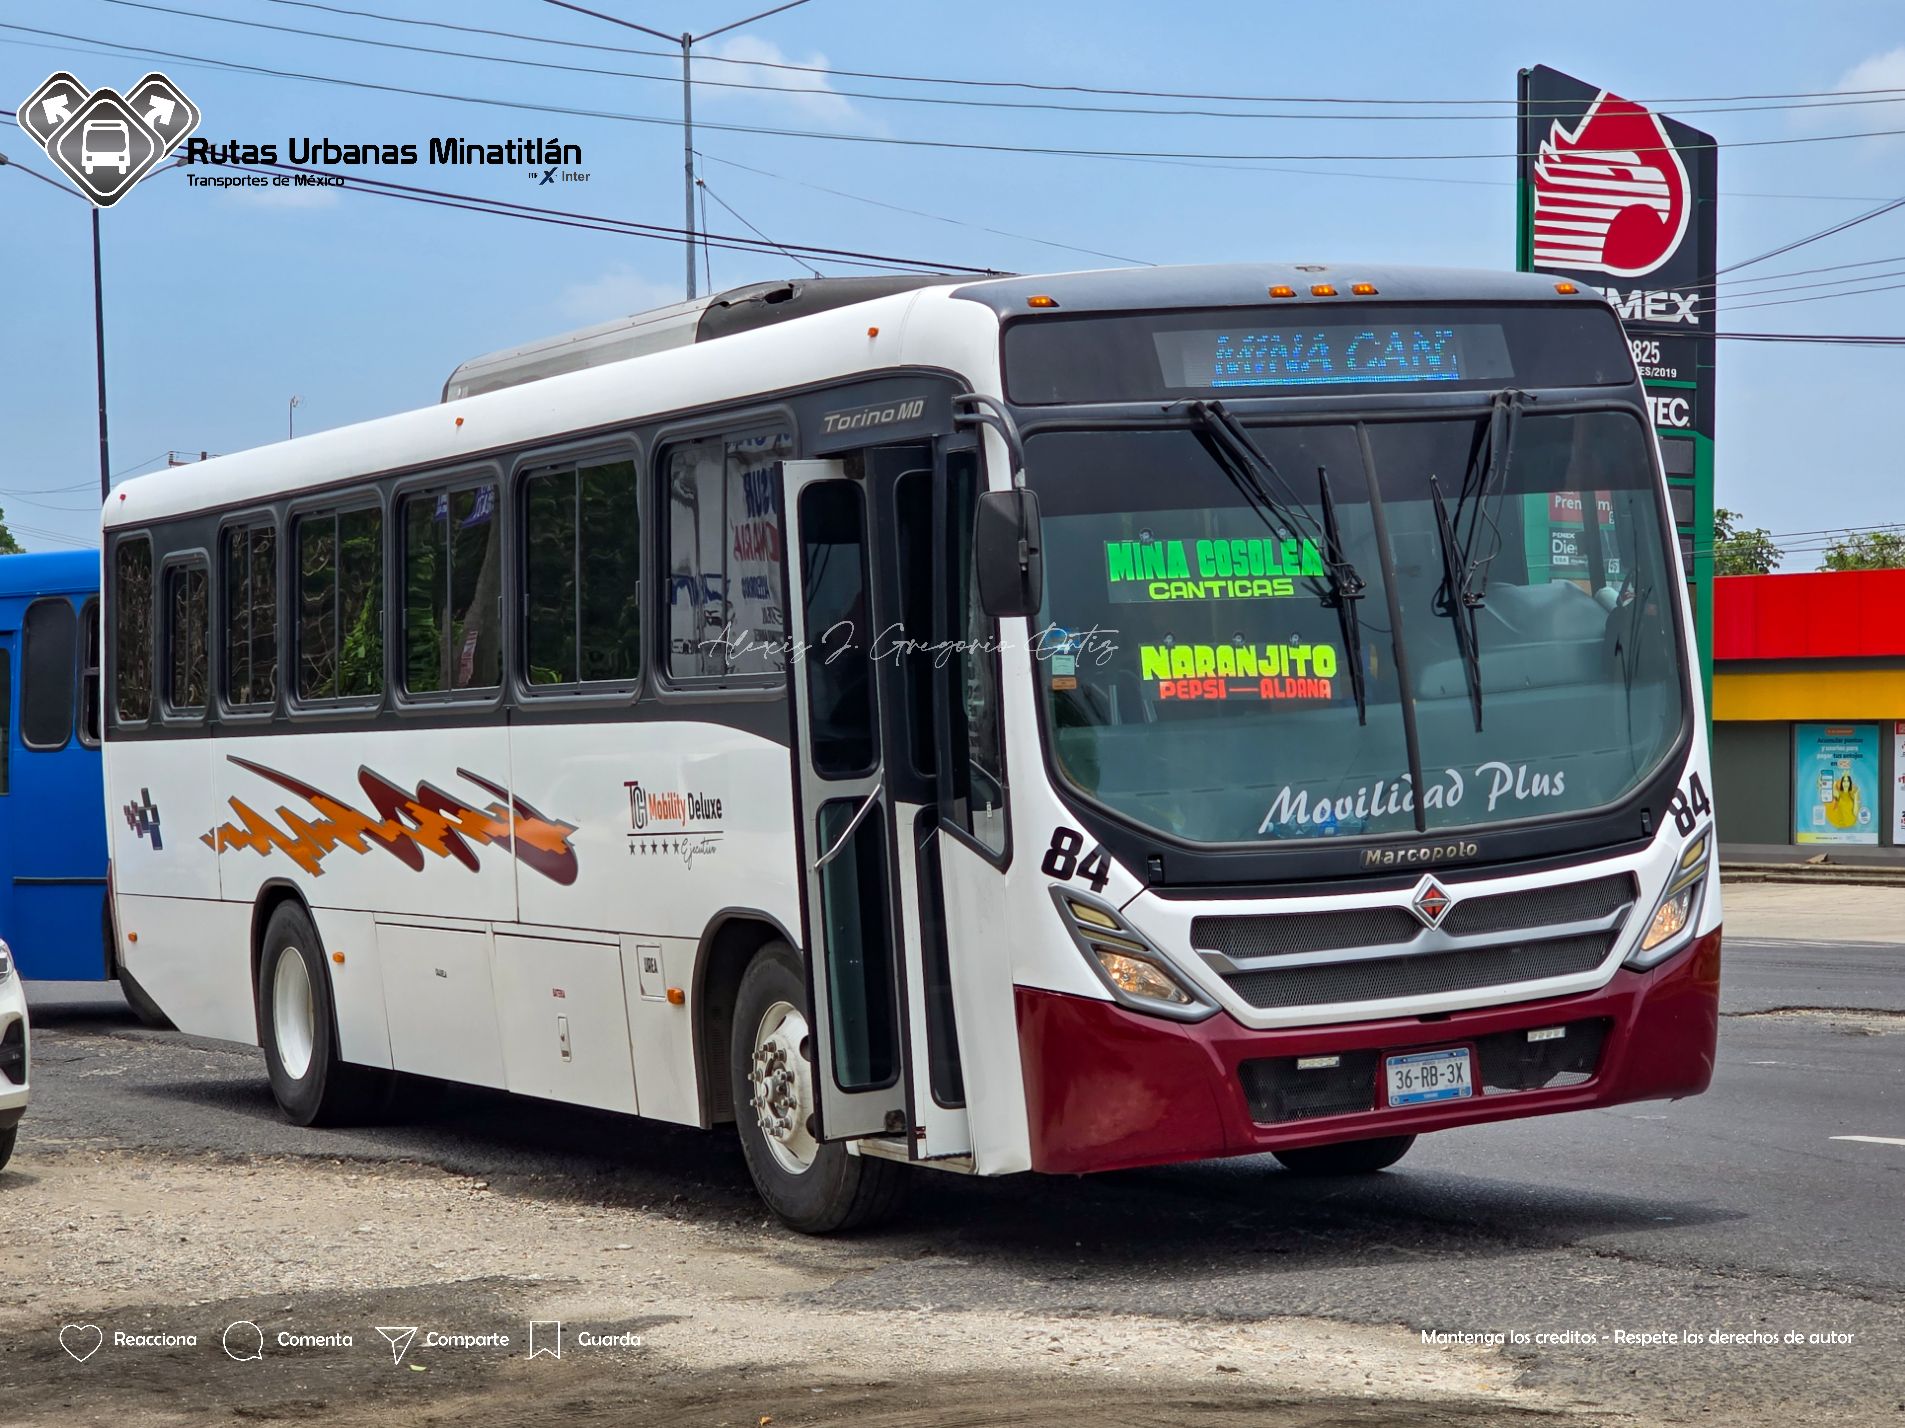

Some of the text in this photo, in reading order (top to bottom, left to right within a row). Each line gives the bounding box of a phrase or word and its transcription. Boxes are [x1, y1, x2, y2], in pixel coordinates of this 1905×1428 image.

[1592, 286, 1699, 324] MEX
[1215, 333, 1333, 375] MINA
[1637, 366, 1677, 378] ES/2019
[824, 400, 925, 433] Torino MD
[1107, 538, 1324, 582] MINA COSOLEA
[1149, 578, 1295, 600] CANTICAS
[1140, 645, 1337, 681] NARANJITO
[1159, 680, 1227, 700] PEPSI
[1260, 679, 1331, 699] ALDANA
[648, 792, 686, 827] Mobility
[688, 792, 722, 820] Deluxe
[1258, 761, 1566, 834] Movilidad Plus
[1668, 771, 1711, 838] 84
[1041, 826, 1112, 893] 84
[1365, 842, 1479, 866] Marcopolo
[1395, 1062, 1464, 1090] 36-RB-3X
